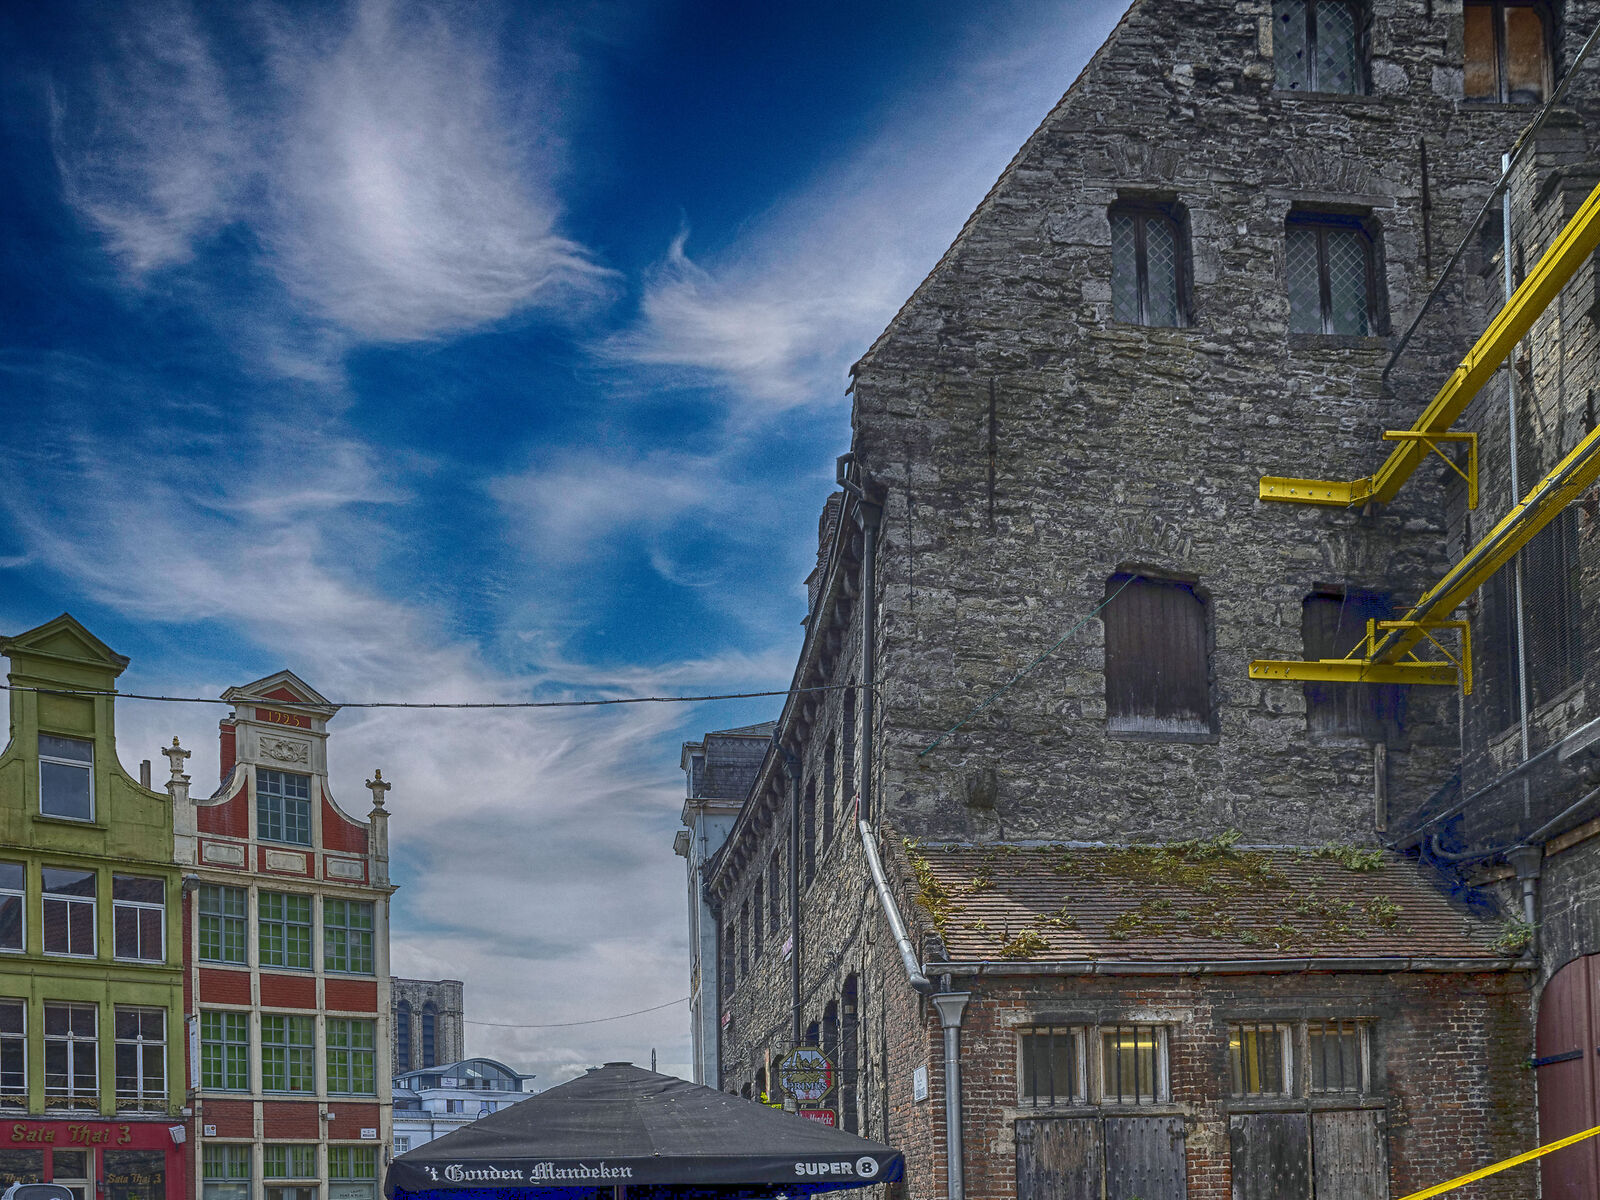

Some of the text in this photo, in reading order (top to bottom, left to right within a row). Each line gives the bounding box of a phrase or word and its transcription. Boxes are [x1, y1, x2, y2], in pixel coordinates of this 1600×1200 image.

[787, 1081, 827, 1090] PRIMUS
[11, 1124, 132, 1146] Sala Thai 3
[444, 1164, 524, 1182] Gouden
[529, 1161, 633, 1184] Mandeken
[795, 1162, 853, 1176] SUPER
[107, 1173, 129, 1184] Sala
[131, 1173, 151, 1185] Thai
